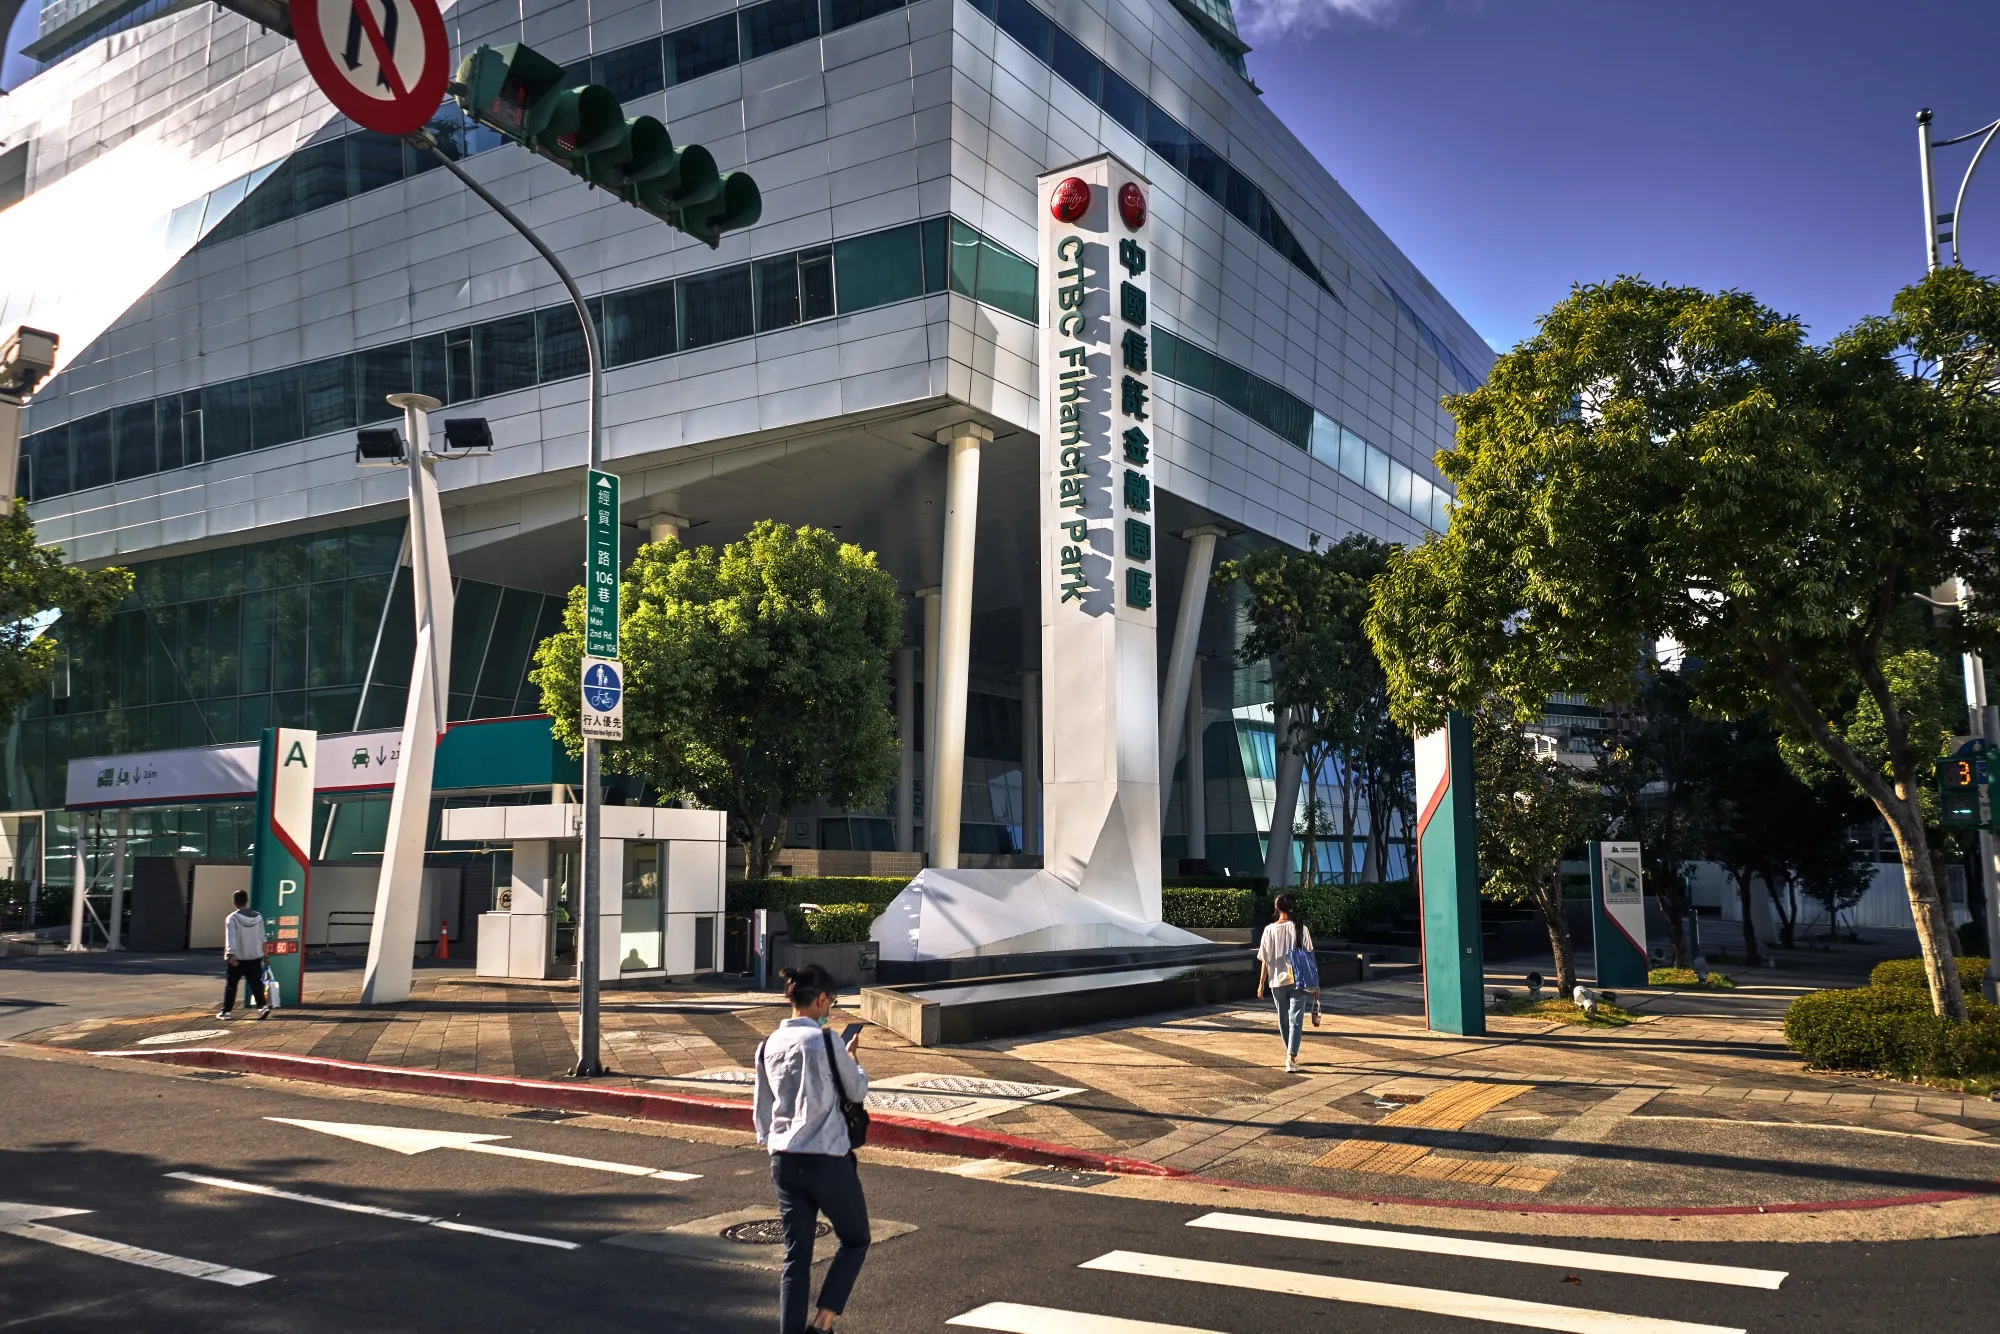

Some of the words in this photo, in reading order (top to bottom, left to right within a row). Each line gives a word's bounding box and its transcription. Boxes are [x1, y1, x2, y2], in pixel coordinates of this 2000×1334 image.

[1058, 235, 1085, 338] CTBC
[1059, 346, 1087, 508] Financial
[1119, 238, 1152, 609] 中國信託金融園區
[1060, 519, 1088, 604] Park
[590, 603, 604, 616] Jing
[590, 617, 603, 626] Mao
[589, 629, 602, 638] 2nd
[589, 641, 605, 651] Lane
[606, 644, 617, 653] 106
[583, 714, 622, 729] 行人優先
[284, 740, 308, 768] A
[390, 750, 400, 760] 2.1
[1959, 761, 1971, 785] 3
[278, 879, 297, 907] P
